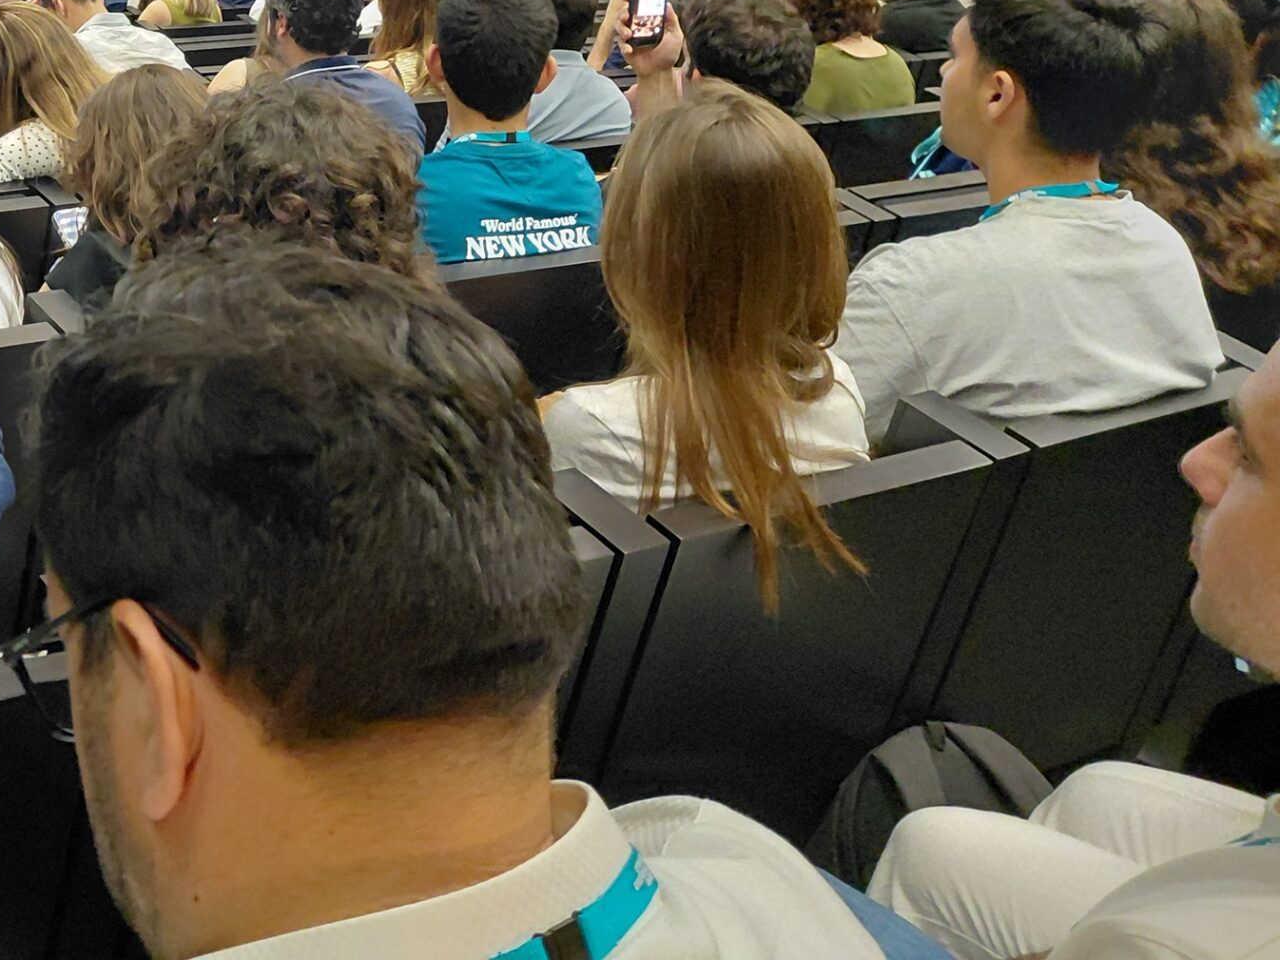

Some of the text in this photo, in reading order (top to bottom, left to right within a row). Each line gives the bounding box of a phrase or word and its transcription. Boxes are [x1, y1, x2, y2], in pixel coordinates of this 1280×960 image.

[481, 214, 577, 232] World Famous
[465, 226, 592, 259] NEW YORK
